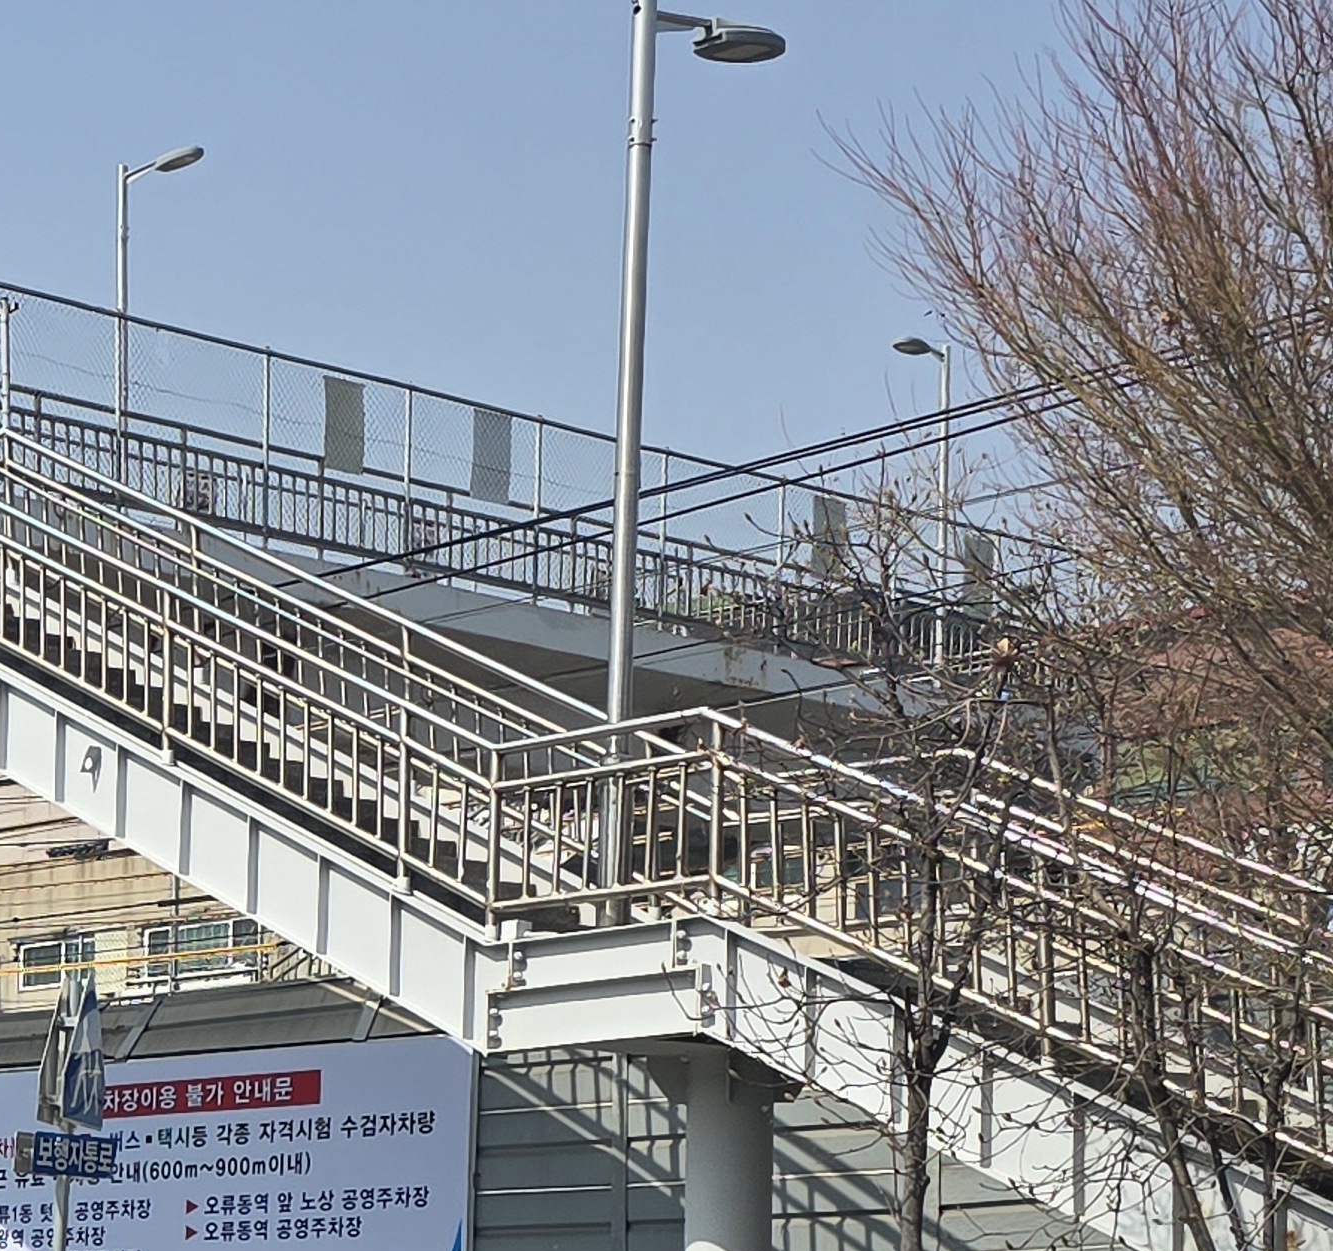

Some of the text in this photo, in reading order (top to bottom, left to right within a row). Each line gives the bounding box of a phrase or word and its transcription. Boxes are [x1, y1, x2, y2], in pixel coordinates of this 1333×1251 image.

[104, 1076, 293, 1113] 차장이용 불가 안내문
[216, 1122, 251, 1147] 각종
[259, 1116, 332, 1144] 자격시험
[340, 1109, 436, 1140] 수검자차량
[36, 1136, 114, 1174] 보행자통로
[74, 1198, 152, 1222] 공영주차장
[203, 1185, 431, 1216] 오류동역 앞 노상 공영주차장
[203, 1216, 362, 1242] 오류동역 공영주차장
